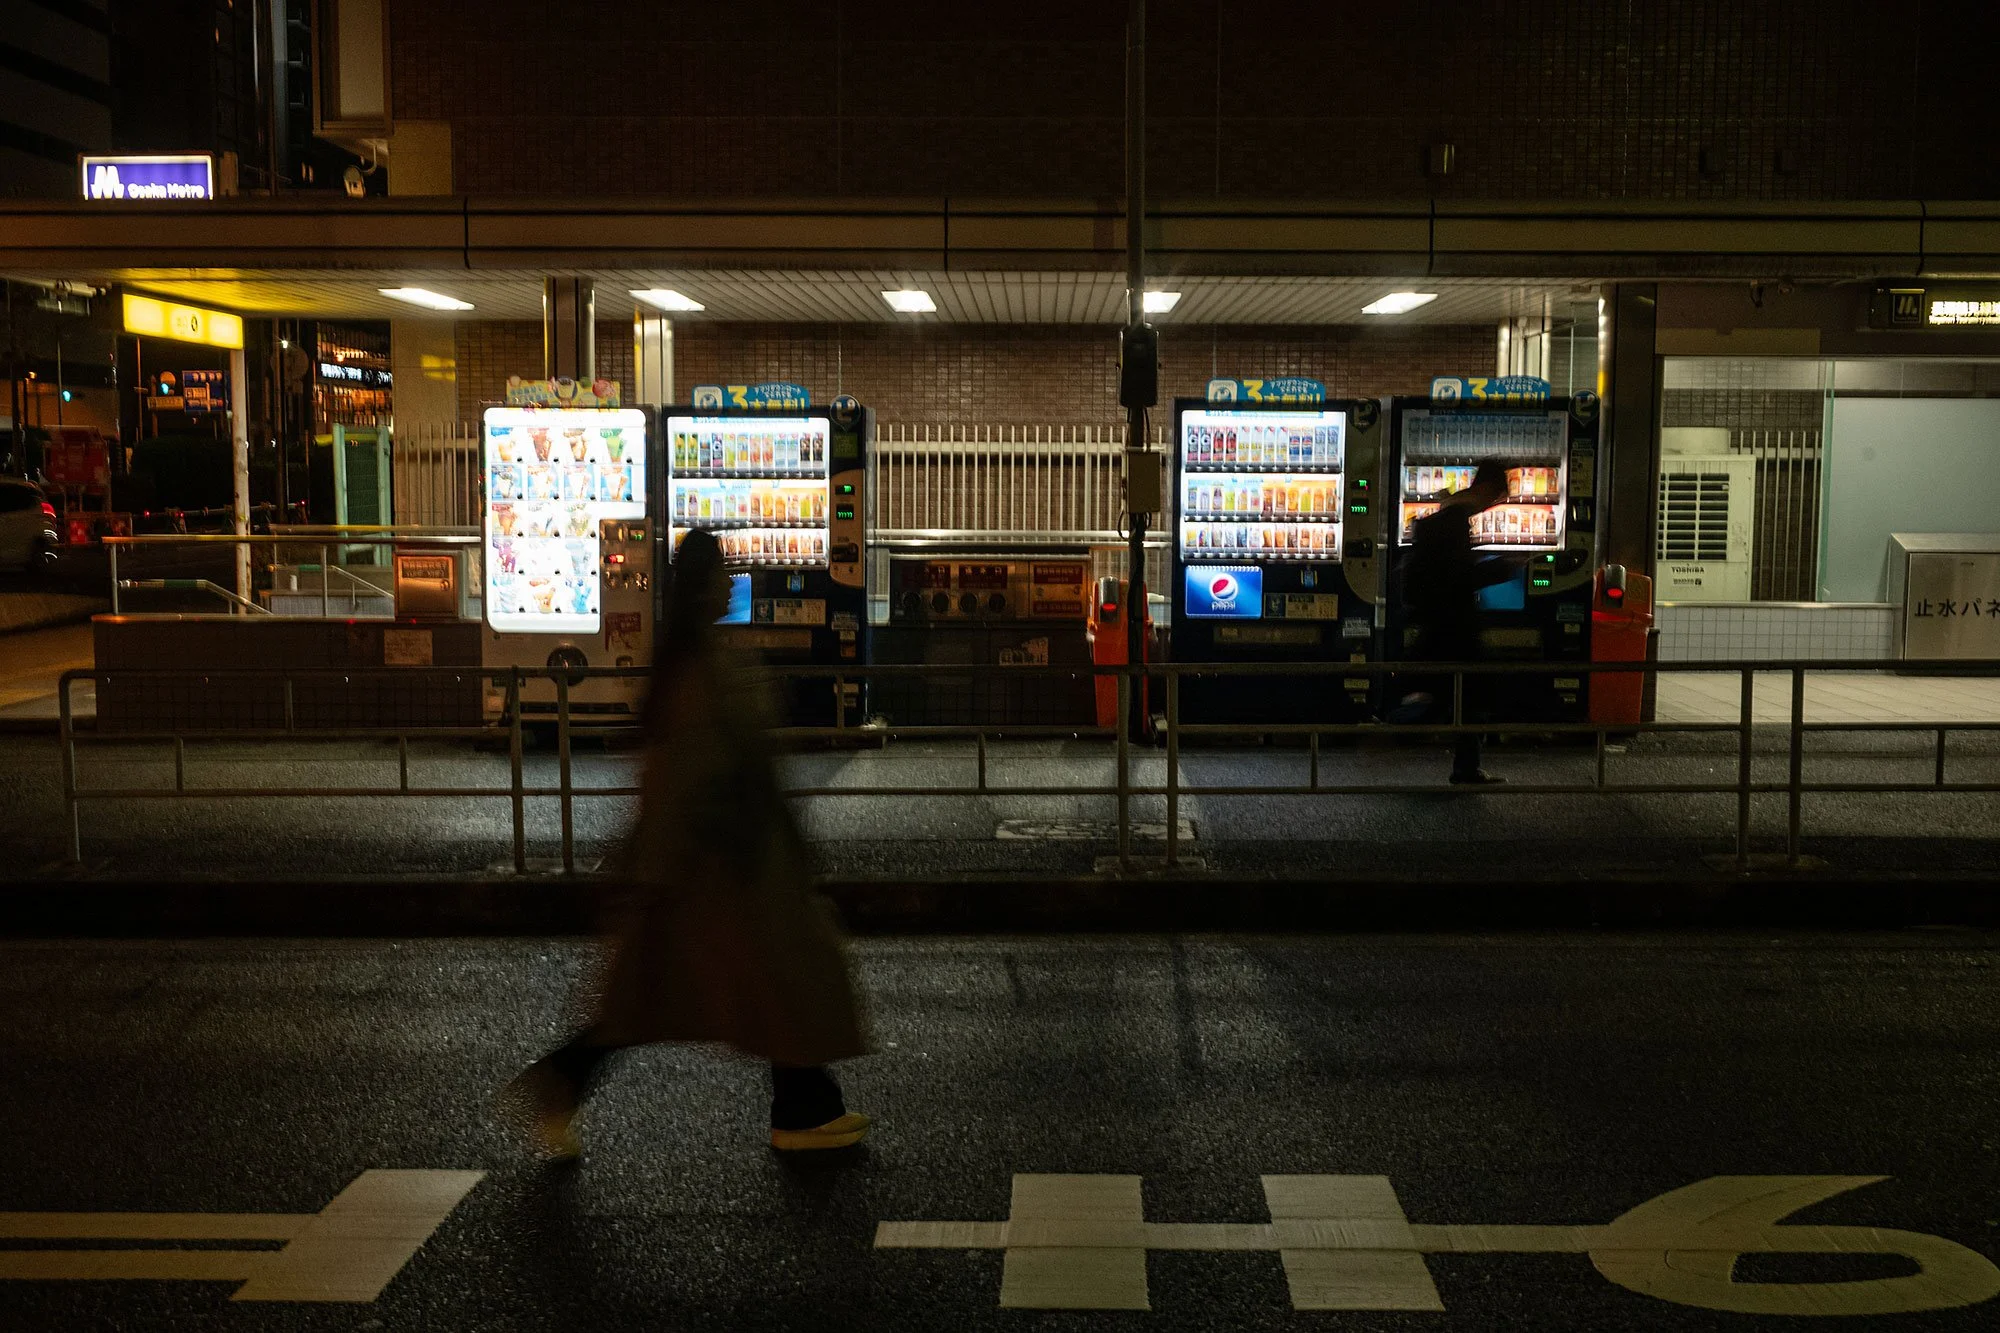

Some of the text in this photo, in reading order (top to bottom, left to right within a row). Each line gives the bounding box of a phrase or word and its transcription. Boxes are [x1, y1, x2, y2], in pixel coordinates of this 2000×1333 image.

[128, 182, 167, 199] Osaka
[167, 182, 205, 199] Metro
[1671, 566, 1705, 574] TOSHIBA
[1210, 599, 1237, 612] pepsi
[1914, 597, 2000, 619] 止水パネ
